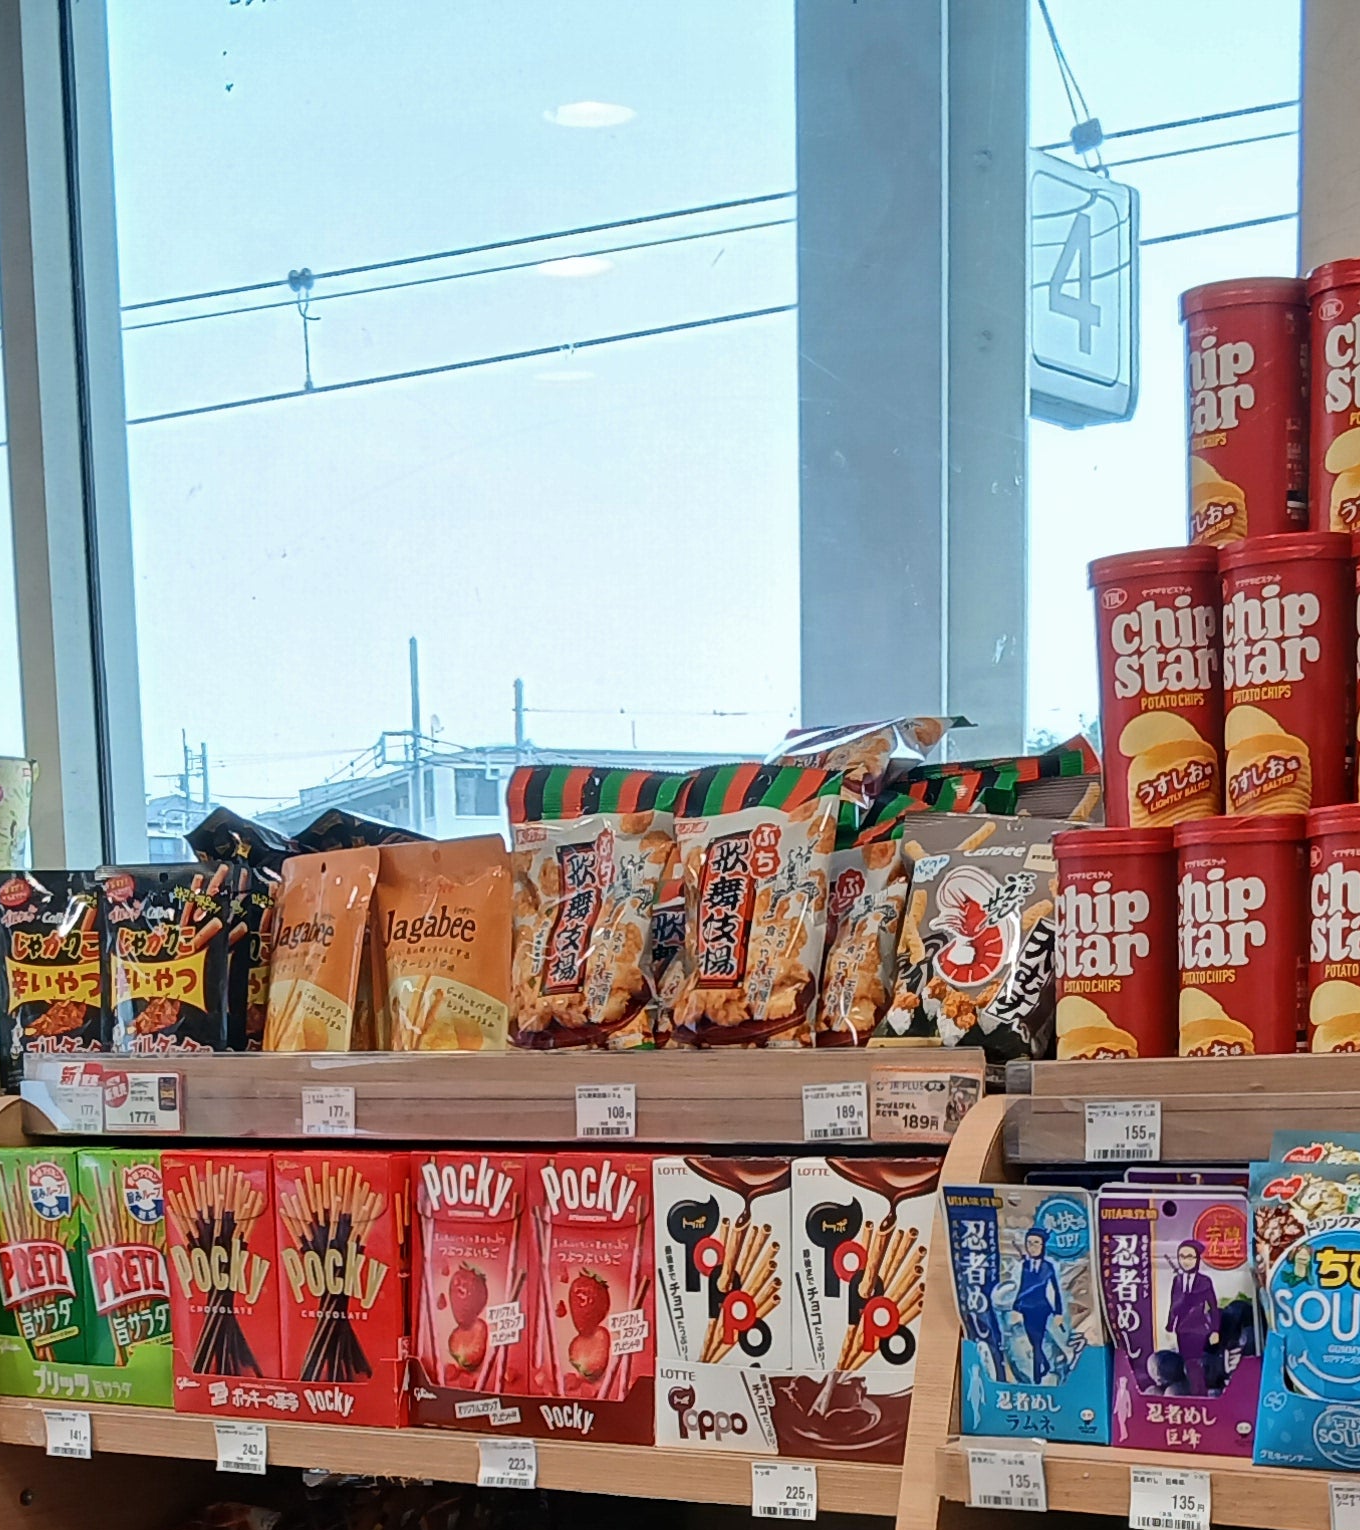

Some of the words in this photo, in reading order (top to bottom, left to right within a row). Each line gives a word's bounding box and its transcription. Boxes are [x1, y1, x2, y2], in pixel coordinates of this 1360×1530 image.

[1049, 212, 1102, 356] 4
[1112, 594, 1217, 656] chip
[1114, 643, 1218, 700] star
[702, 838, 748, 978] 歌舞伎揚
[386, 904, 476, 946] Jagabee
[116, 927, 196, 960] じゃがりこ
[115, 965, 199, 997] 辛いやつ
[1324, 964, 1360, 979] POTATO
[905, 1080, 924, 1091] PLUS
[129, 1111, 156, 1125] 177円
[901, 1113, 940, 1131] 189円
[1124, 1125, 1157, 1140] 155円
[657, 1166, 689, 1176] LOTTE
[556, 1250, 622, 1266] つぶつぶいちご
[961, 1218, 989, 1340] 忍者めし
[1110, 1233, 1142, 1358] 忍者めし
[21, 1299, 73, 1341] 旨サラダ
[301, 1309, 369, 1320] CHOCOLATE
[33, 1369, 89, 1396] プリッツ
[660, 1368, 696, 1382] LOTTE
[995, 1391, 1061, 1413] 忍者めし
[1006, 1413, 1055, 1434] ラムネ
[1146, 1403, 1216, 1426] 忍者めし
[1165, 1428, 1200, 1449] 巨峰
[785, 1485, 814, 1501] 225円
[1171, 1495, 1205, 1513] 135円
